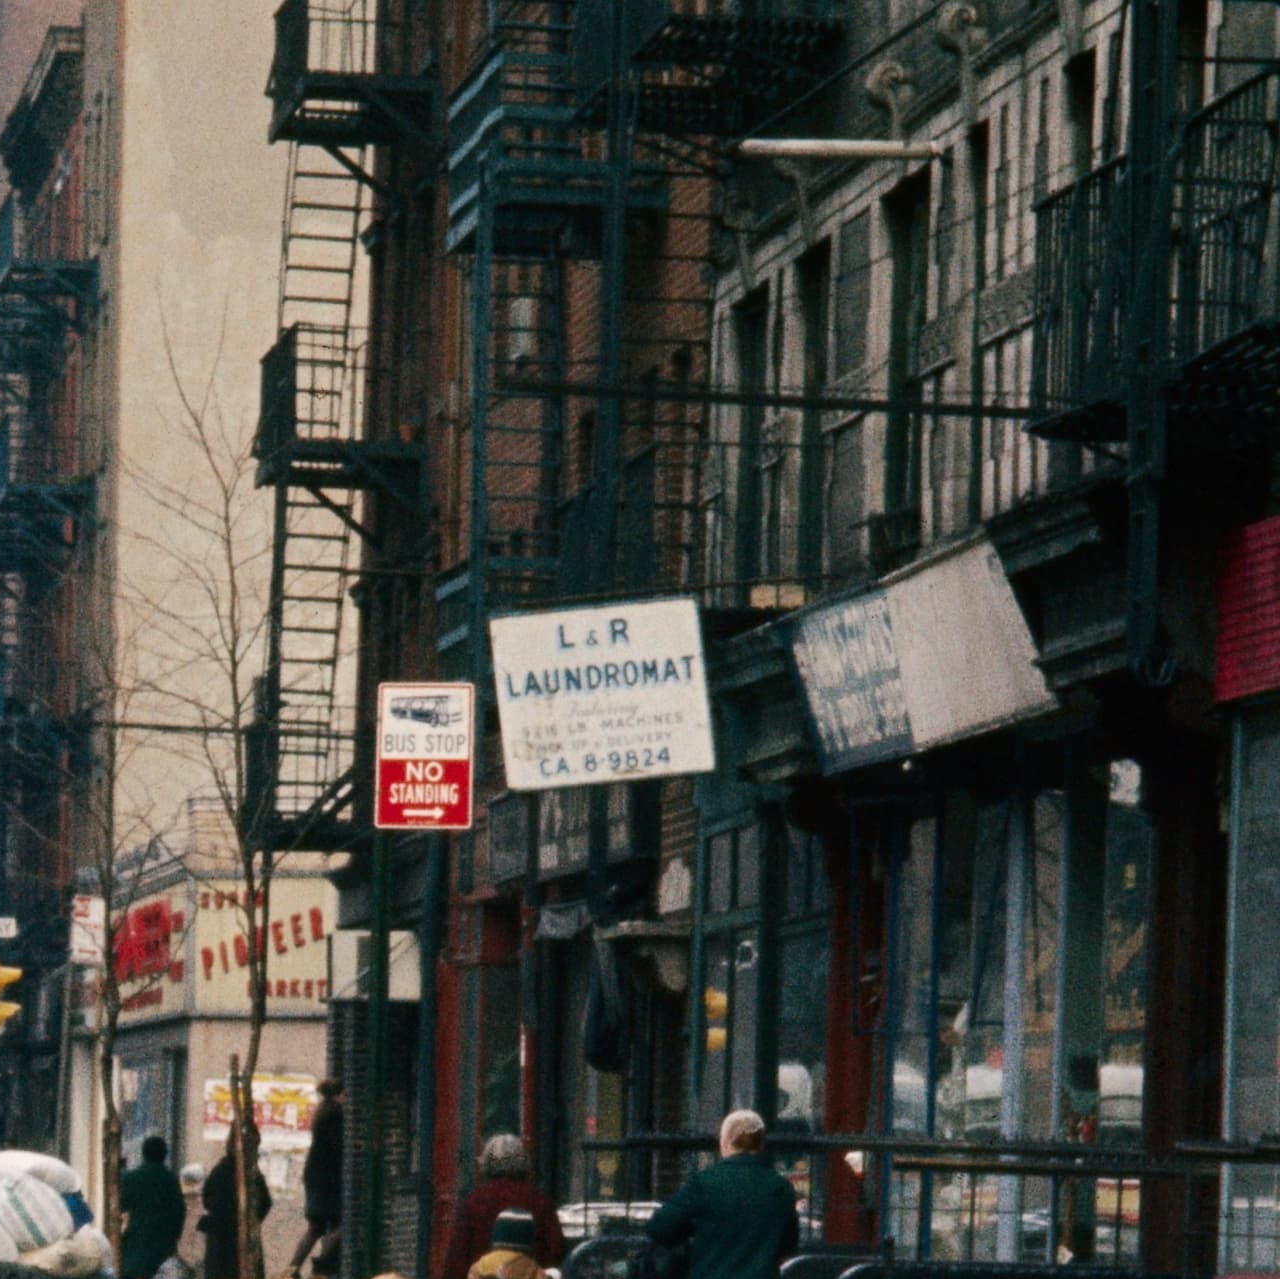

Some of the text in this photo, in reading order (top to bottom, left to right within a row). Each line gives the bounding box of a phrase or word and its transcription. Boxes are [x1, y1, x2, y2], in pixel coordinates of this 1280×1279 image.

[559, 618, 629, 648] L & R
[506, 655, 695, 697] LAUNDROMAT
[600, 711, 684, 729] MACHINES
[384, 734, 466, 753] BUS STOP
[584, 746, 671, 772] 8-9824
[405, 761, 444, 782] NO
[389, 784, 460, 805] STANDING
